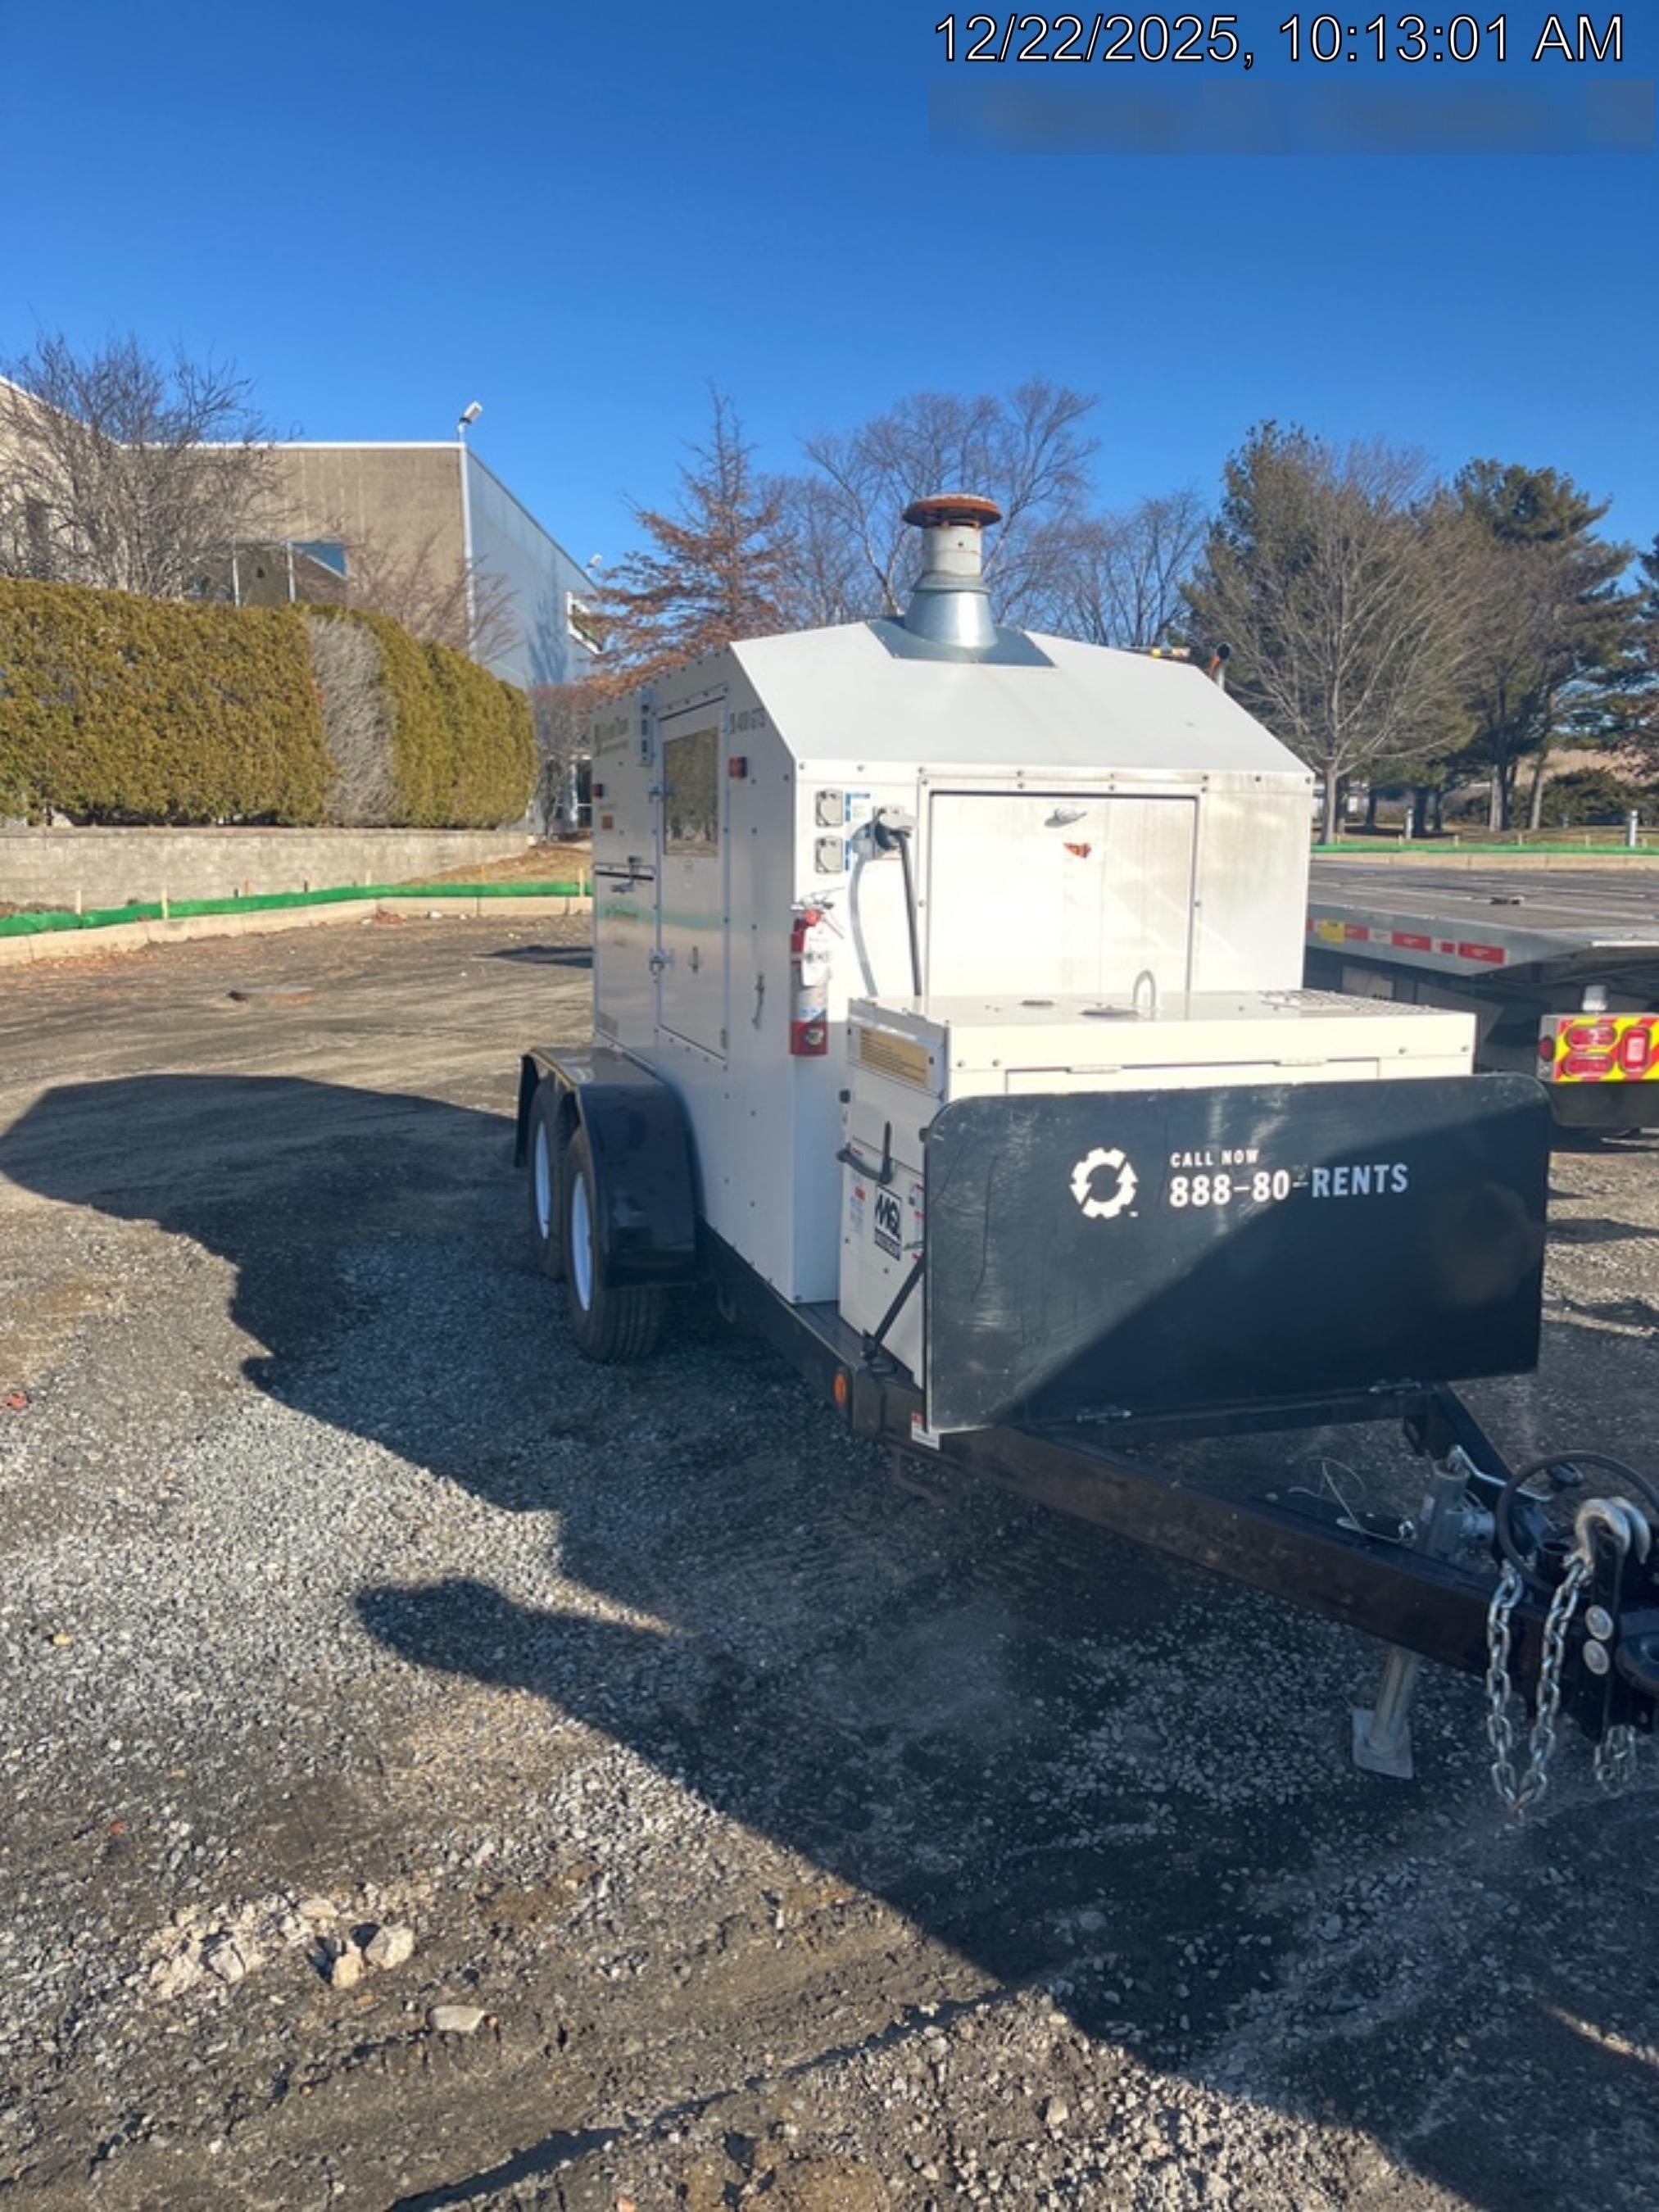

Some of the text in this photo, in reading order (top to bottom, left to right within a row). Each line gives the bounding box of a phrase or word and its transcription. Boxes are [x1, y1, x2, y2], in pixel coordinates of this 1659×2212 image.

[1170, 1148, 1259, 1168] CALL NOW
[1169, 1162, 1408, 1208] 888-80-RENTS
